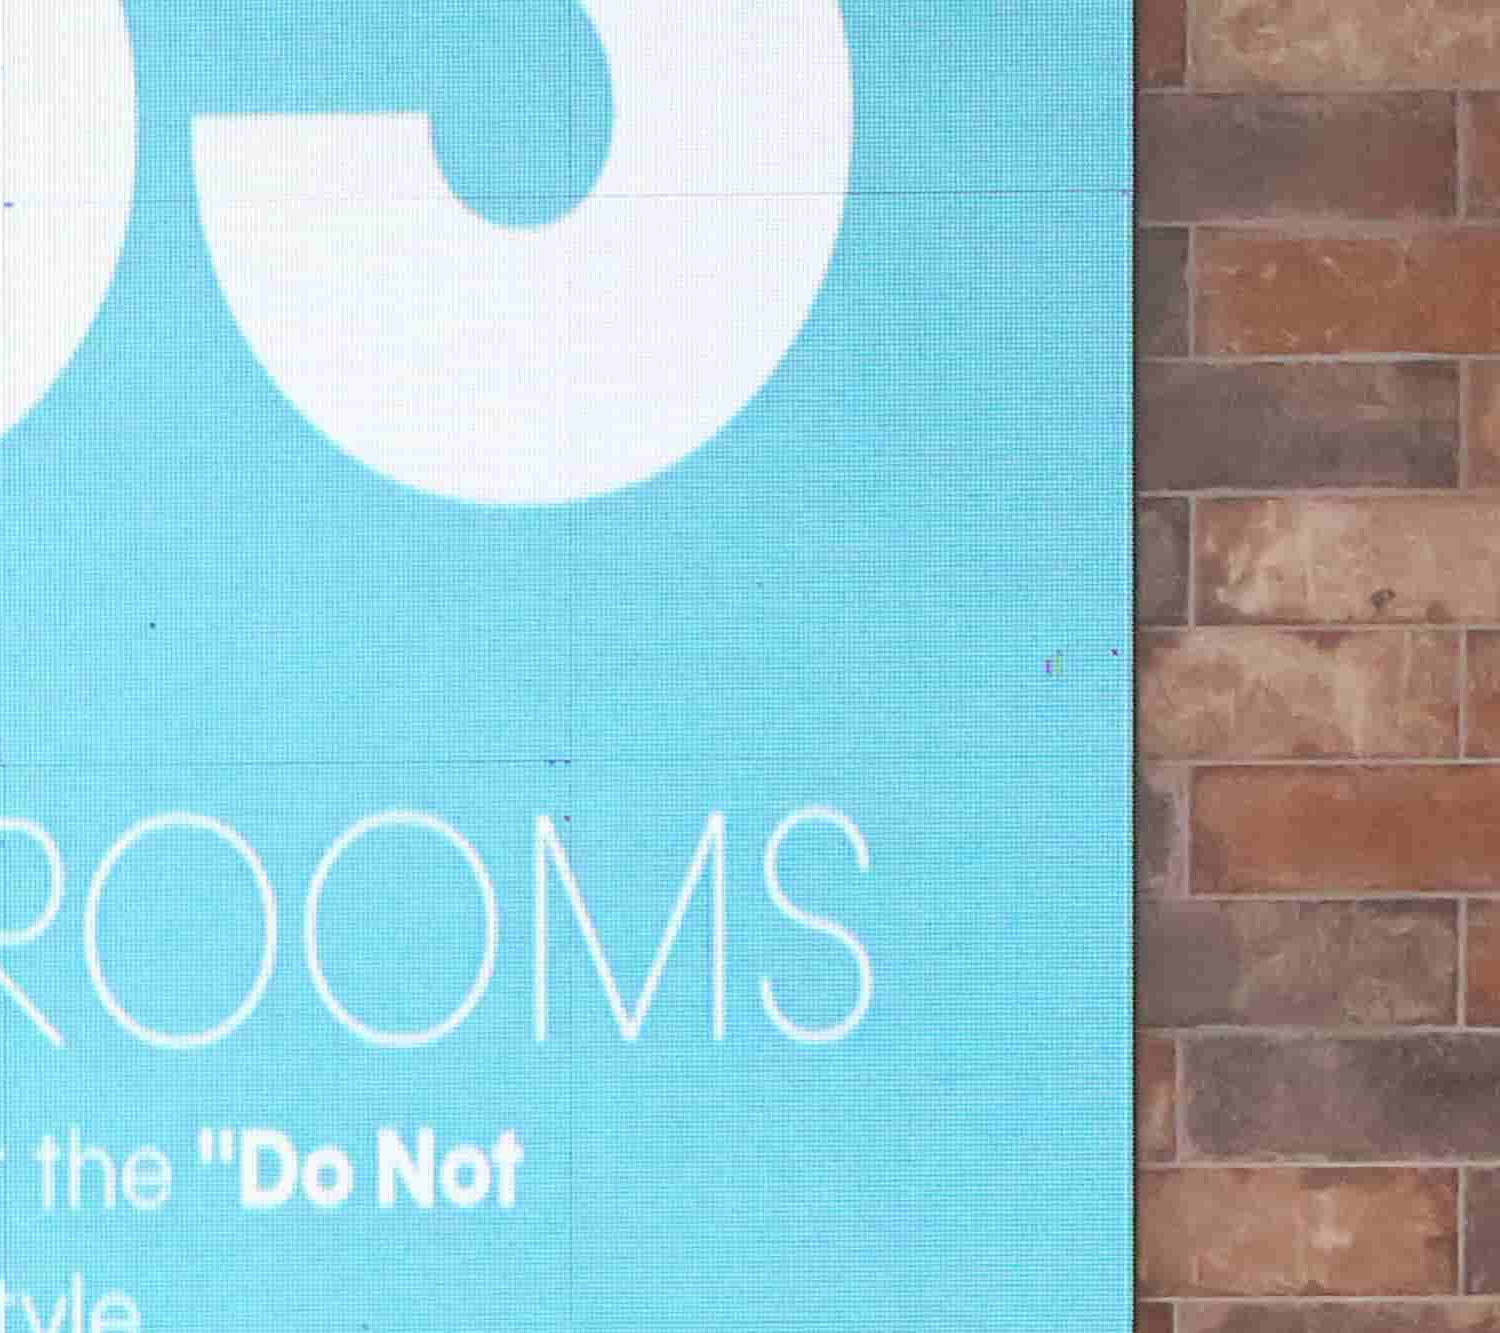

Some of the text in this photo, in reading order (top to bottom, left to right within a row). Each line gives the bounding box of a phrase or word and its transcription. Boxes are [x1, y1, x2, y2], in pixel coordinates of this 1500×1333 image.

[34, 1128, 174, 1210] the
[198, 1126, 353, 1209] "Do
[378, 1127, 524, 1208] Not
